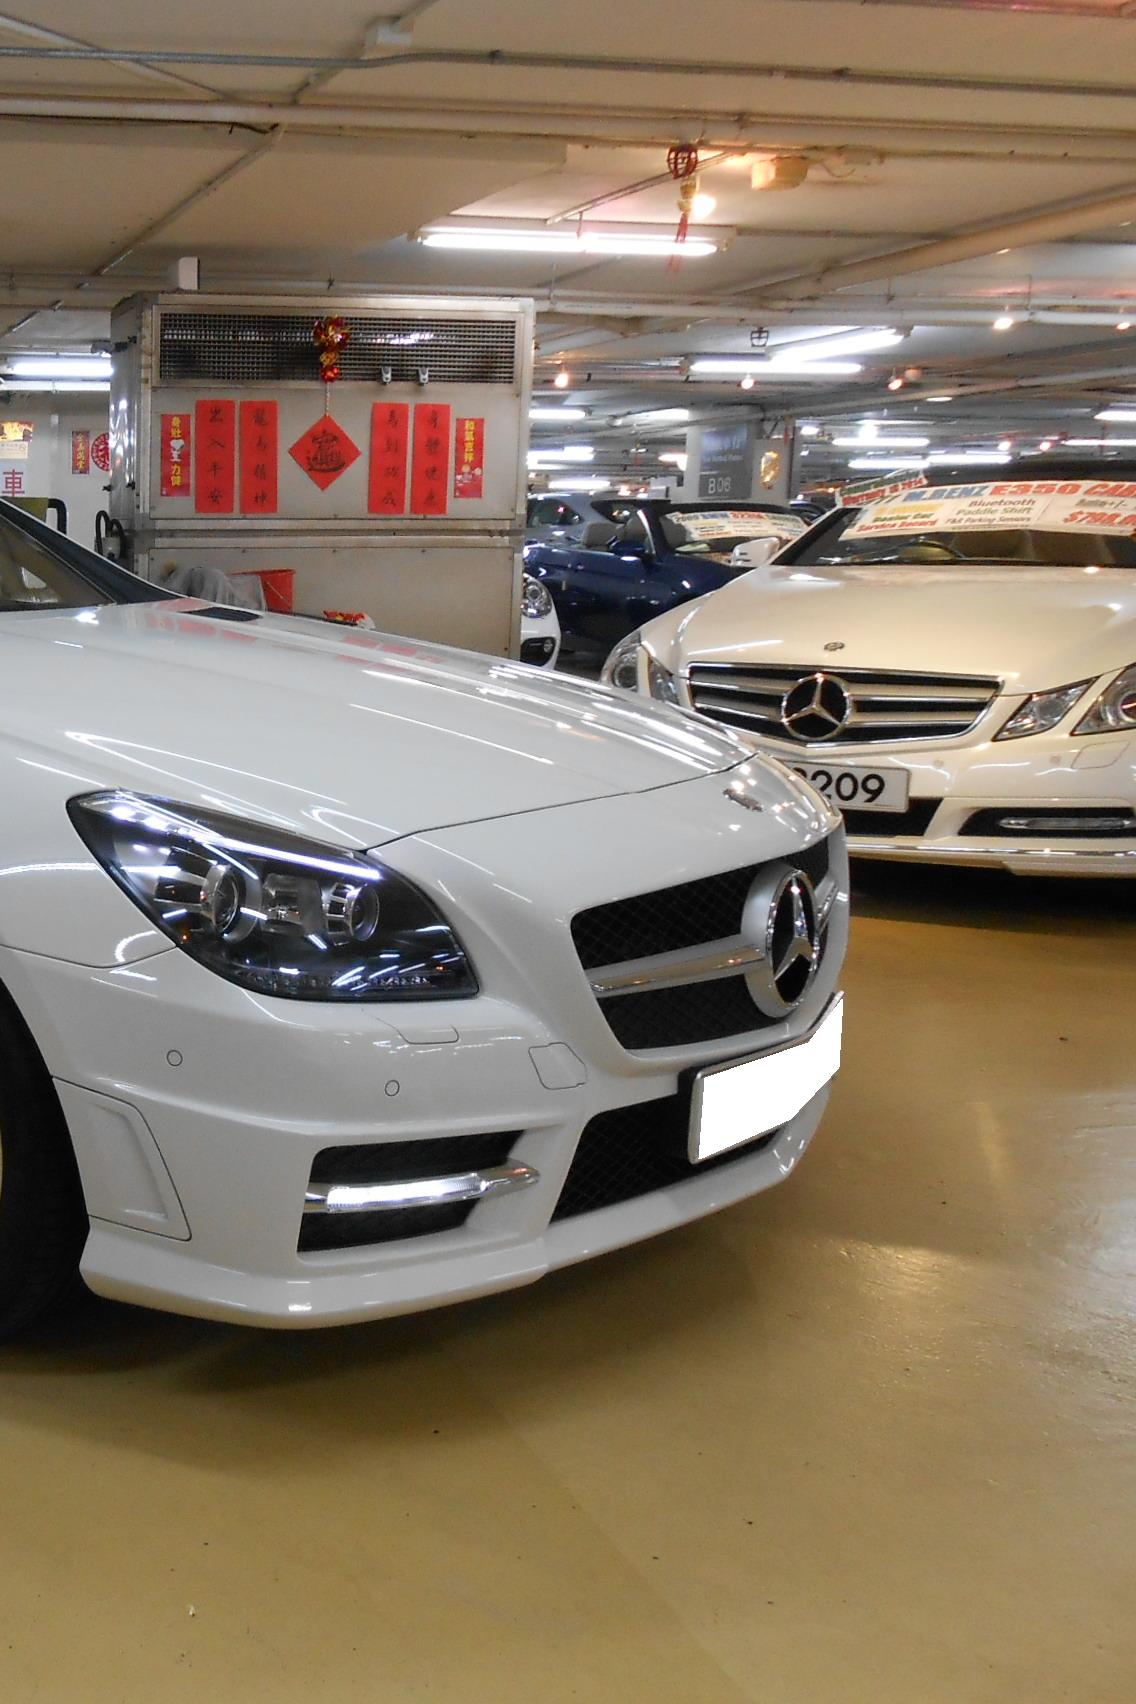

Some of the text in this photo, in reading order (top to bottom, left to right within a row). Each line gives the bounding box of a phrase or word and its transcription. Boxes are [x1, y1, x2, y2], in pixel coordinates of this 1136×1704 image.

[989, 483, 1082, 496] E350
[968, 499, 1036, 508] Bluetooth
[1001, 506, 1033, 515] Shift
